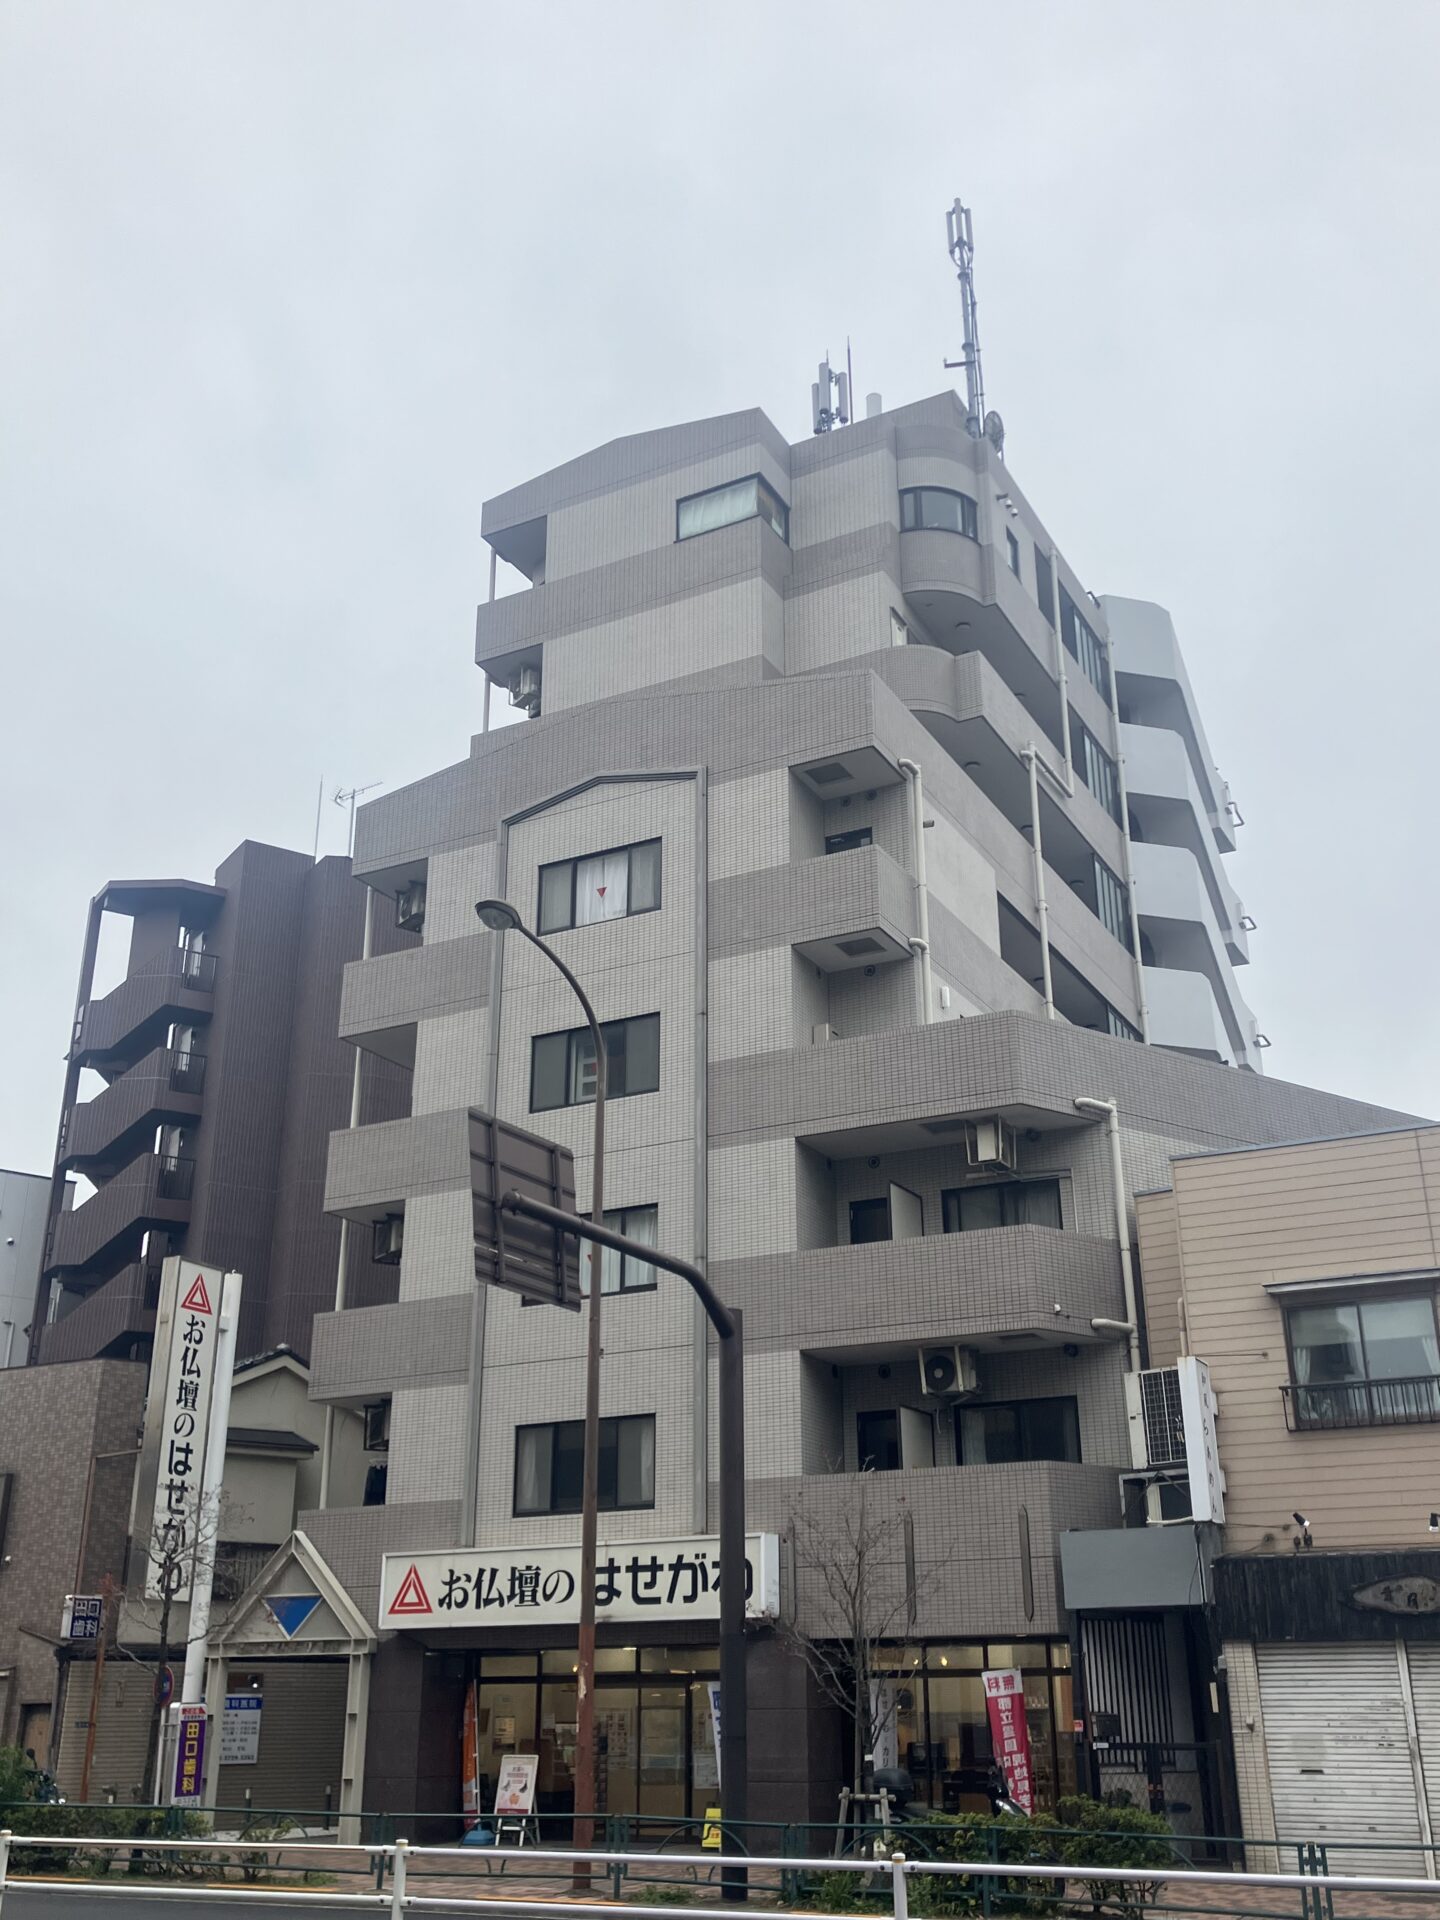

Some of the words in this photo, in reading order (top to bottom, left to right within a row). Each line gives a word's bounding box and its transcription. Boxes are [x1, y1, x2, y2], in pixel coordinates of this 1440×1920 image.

[75, 1600, 100, 1616] 田口
[72, 1620, 98, 1638] 歯科
[182, 1722, 199, 1794] 田口歯科
